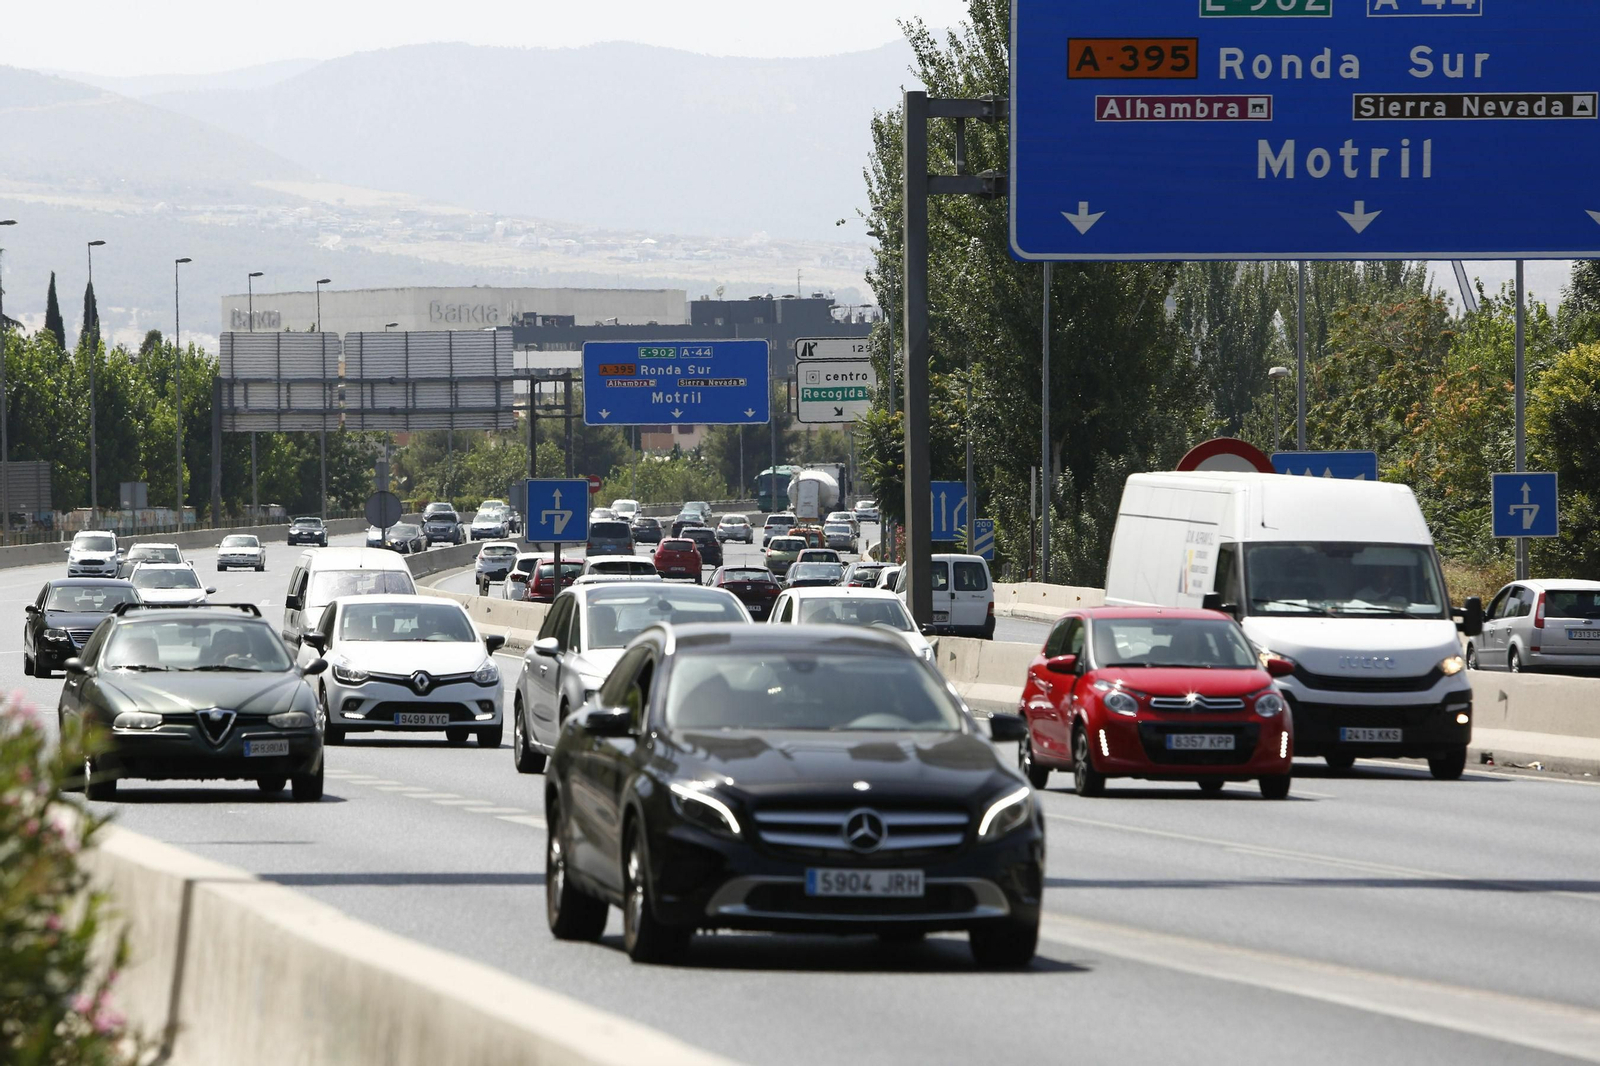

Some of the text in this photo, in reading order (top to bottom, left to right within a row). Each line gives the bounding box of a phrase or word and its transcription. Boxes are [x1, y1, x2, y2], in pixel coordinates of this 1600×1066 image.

[1075, 45, 1490, 79] A-395 Ronda Sur
[1102, 98, 1239, 119] Alhambra
[1359, 96, 1564, 117] Sierra Nevada
[1257, 138, 1432, 179] Motril
[640, 348, 675, 357] E-902
[682, 348, 711, 357] A-44
[601, 364, 711, 375] A-395 Ronda Sur
[825, 372, 868, 381] centro
[651, 391, 702, 404] Motril
[401, 714, 447, 725] 9499 KYC
[1208, 736, 1232, 748] KPP
[821, 871, 920, 893] 5904 JRH
